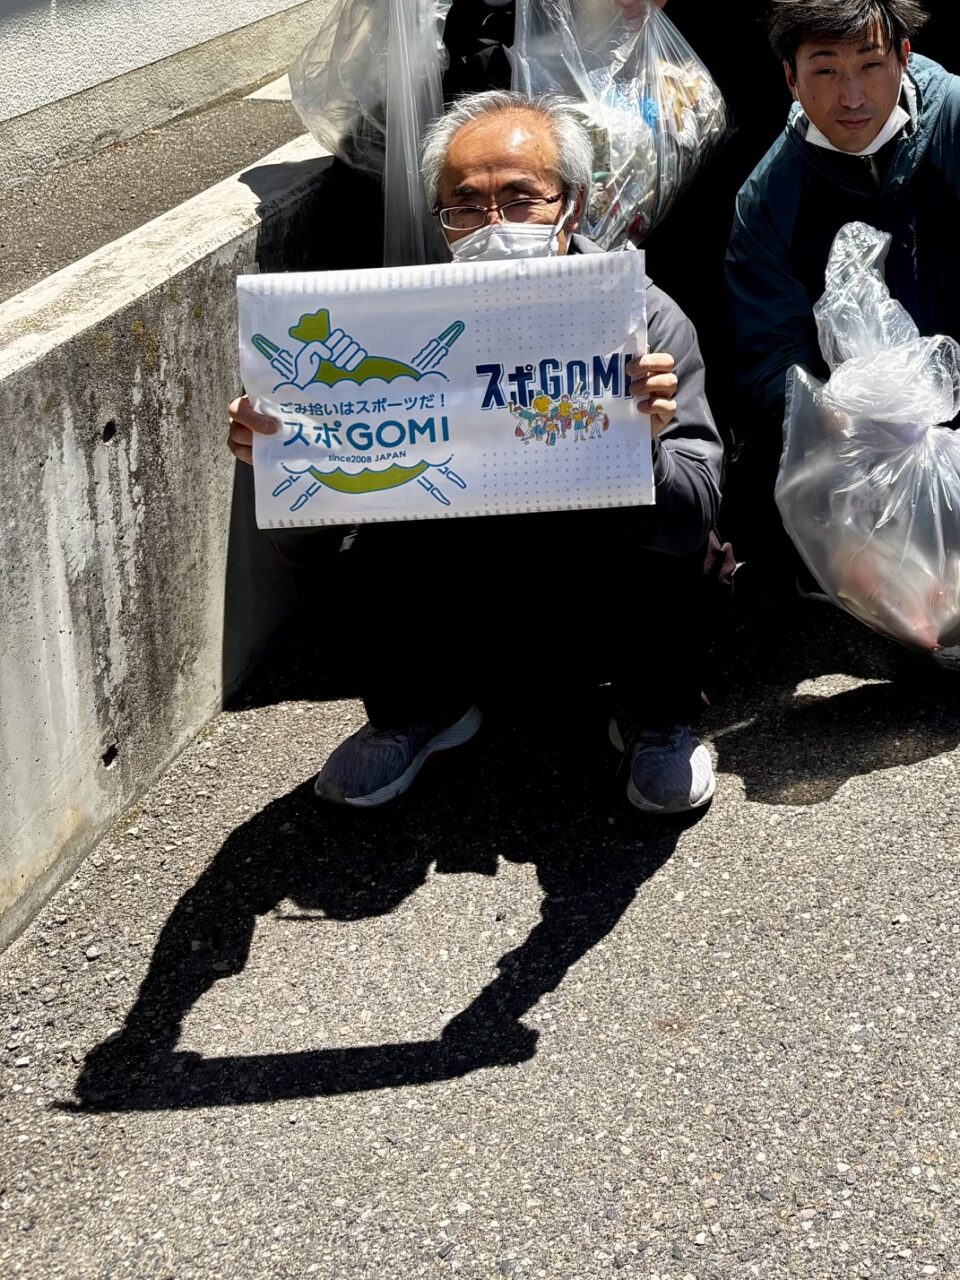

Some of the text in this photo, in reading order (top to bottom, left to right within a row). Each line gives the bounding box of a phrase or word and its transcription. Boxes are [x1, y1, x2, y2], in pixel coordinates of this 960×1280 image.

[279, 393, 446, 417] ごみ拾いはスポーツだ！
[282, 416, 450, 451] スポGOMI
[375, 450, 407, 463] JAPAN
